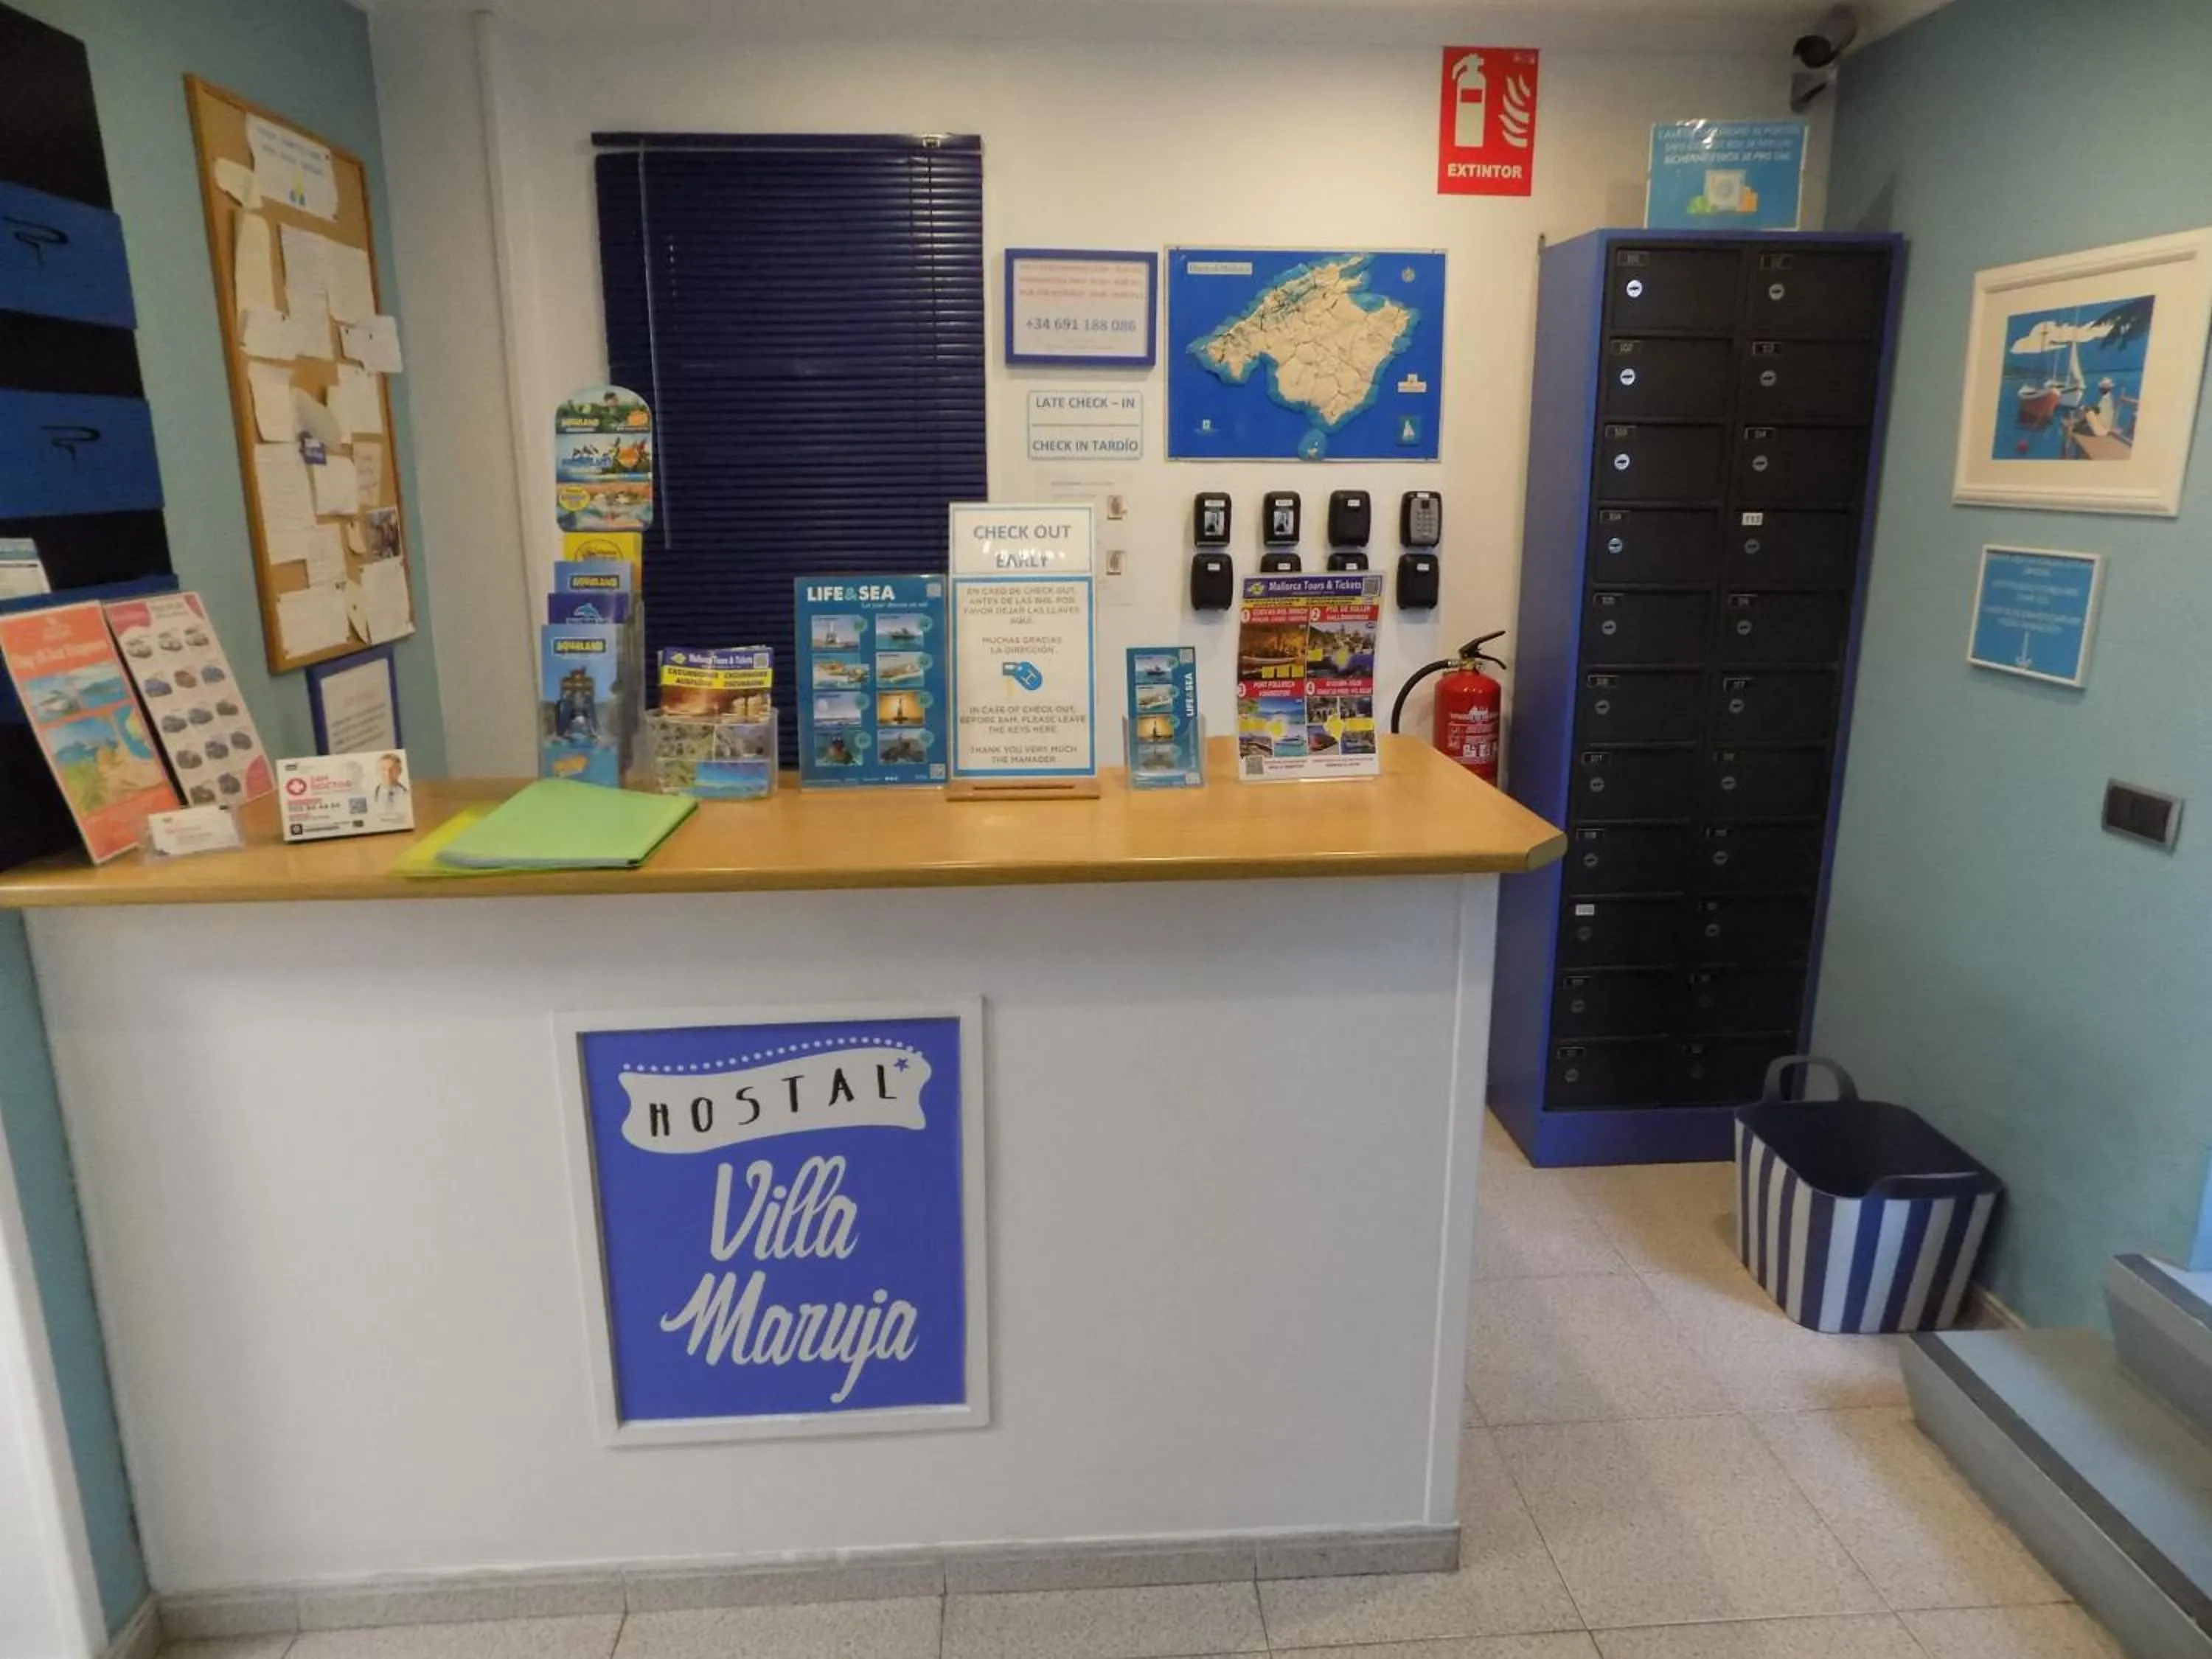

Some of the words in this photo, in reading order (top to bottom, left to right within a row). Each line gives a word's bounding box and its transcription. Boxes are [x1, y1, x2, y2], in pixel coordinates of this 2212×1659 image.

[1447, 163, 1523, 178] EXTINTOR
[1026, 317, 1051, 331] +34
[1054, 318, 1079, 331] 691
[1084, 319, 1108, 332] 188
[1111, 319, 1136, 333] 086
[1036, 397, 1065, 408] LATE
[1068, 397, 1108, 408] CHECK
[1121, 397, 1135, 409] IN
[1032, 440, 1071, 451] CHECK
[1076, 441, 1089, 451] IN
[1092, 438, 1139, 452] TARDÍO
[973, 525, 1029, 540] CHECK
[1034, 524, 1072, 539] OUT
[995, 554, 1049, 568] EARLY
[1269, 580, 1302, 590] Mallorca
[1304, 580, 1325, 590] Tours
[1326, 580, 1334, 590] &
[1335, 579, 1362, 590] Tickets
[964, 606, 993, 614] FAVOR
[1046, 606, 1081, 614] LLAVES
[1023, 636, 1062, 644] GRACIAS
[1058, 715, 1086, 723] LEAVE
[989, 726, 1005, 734] THE
[1007, 726, 1031, 734] KEYS
[970, 745, 1002, 754] THANK
[1004, 745, 1023, 754] YOU
[1025, 745, 1048, 754] VERY
[991, 756, 1008, 764] THE
[649, 1065, 898, 1138] HOSTAL
[709, 1155, 860, 1261] Villa
[660, 1271, 919, 1403] Maruja
